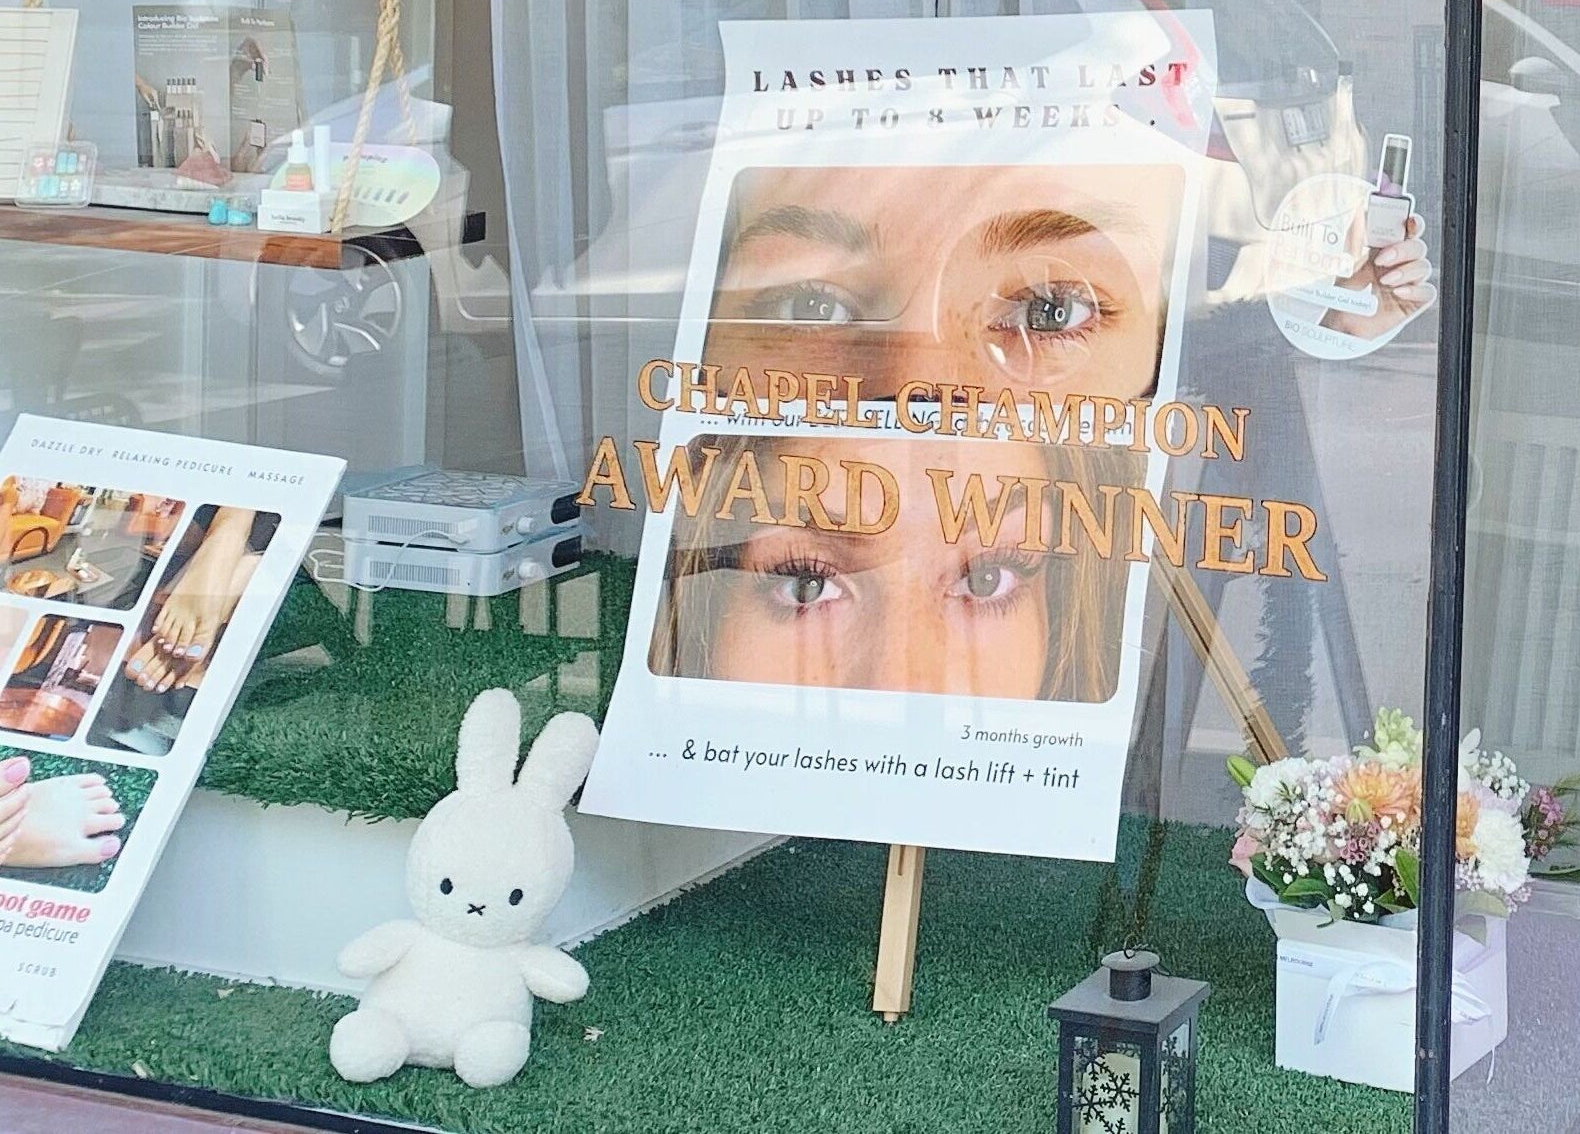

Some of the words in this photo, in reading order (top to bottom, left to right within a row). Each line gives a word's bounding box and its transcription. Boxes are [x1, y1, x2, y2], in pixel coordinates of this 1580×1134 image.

[752, 67, 912, 92] LASHES
[938, 66, 1051, 90] THAT
[1078, 62, 1189, 88] LAST
[776, 108, 824, 130] UP
[852, 107, 899, 130] TO
[927, 107, 945, 124] 8
[1322, 224, 1339, 245] To
[1285, 320, 1300, 333] BIO
[638, 359, 878, 429] CHAPEL
[896, 380, 1250, 463] CHAMPION
[31, 438, 74, 454] DAZZLE
[80, 445, 103, 457] DRY
[112, 449, 169, 467] RELAXING
[176, 459, 232, 476] PEDICURE
[248, 470, 305, 485] MASSAGE
[575, 436, 900, 535] AWARD
[926, 468, 1328, 582] WINNER
[960, 724, 971, 740] 3
[975, 728, 1029, 744] months
[1033, 732, 1084, 749] growth
[681, 739, 697, 761] &
[703, 740, 740, 764] bat
[744, 750, 790, 771] your
[794, 747, 858, 772] lashes
[865, 754, 907, 776] with
[914, 763, 928, 778] a
[934, 757, 980, 782] lash
[986, 761, 1016, 784] lift
[1022, 769, 1035, 783] +
[1043, 766, 1080, 789] tint
[25, 899, 92, 924] game
[13, 920, 80, 944] pedicure
